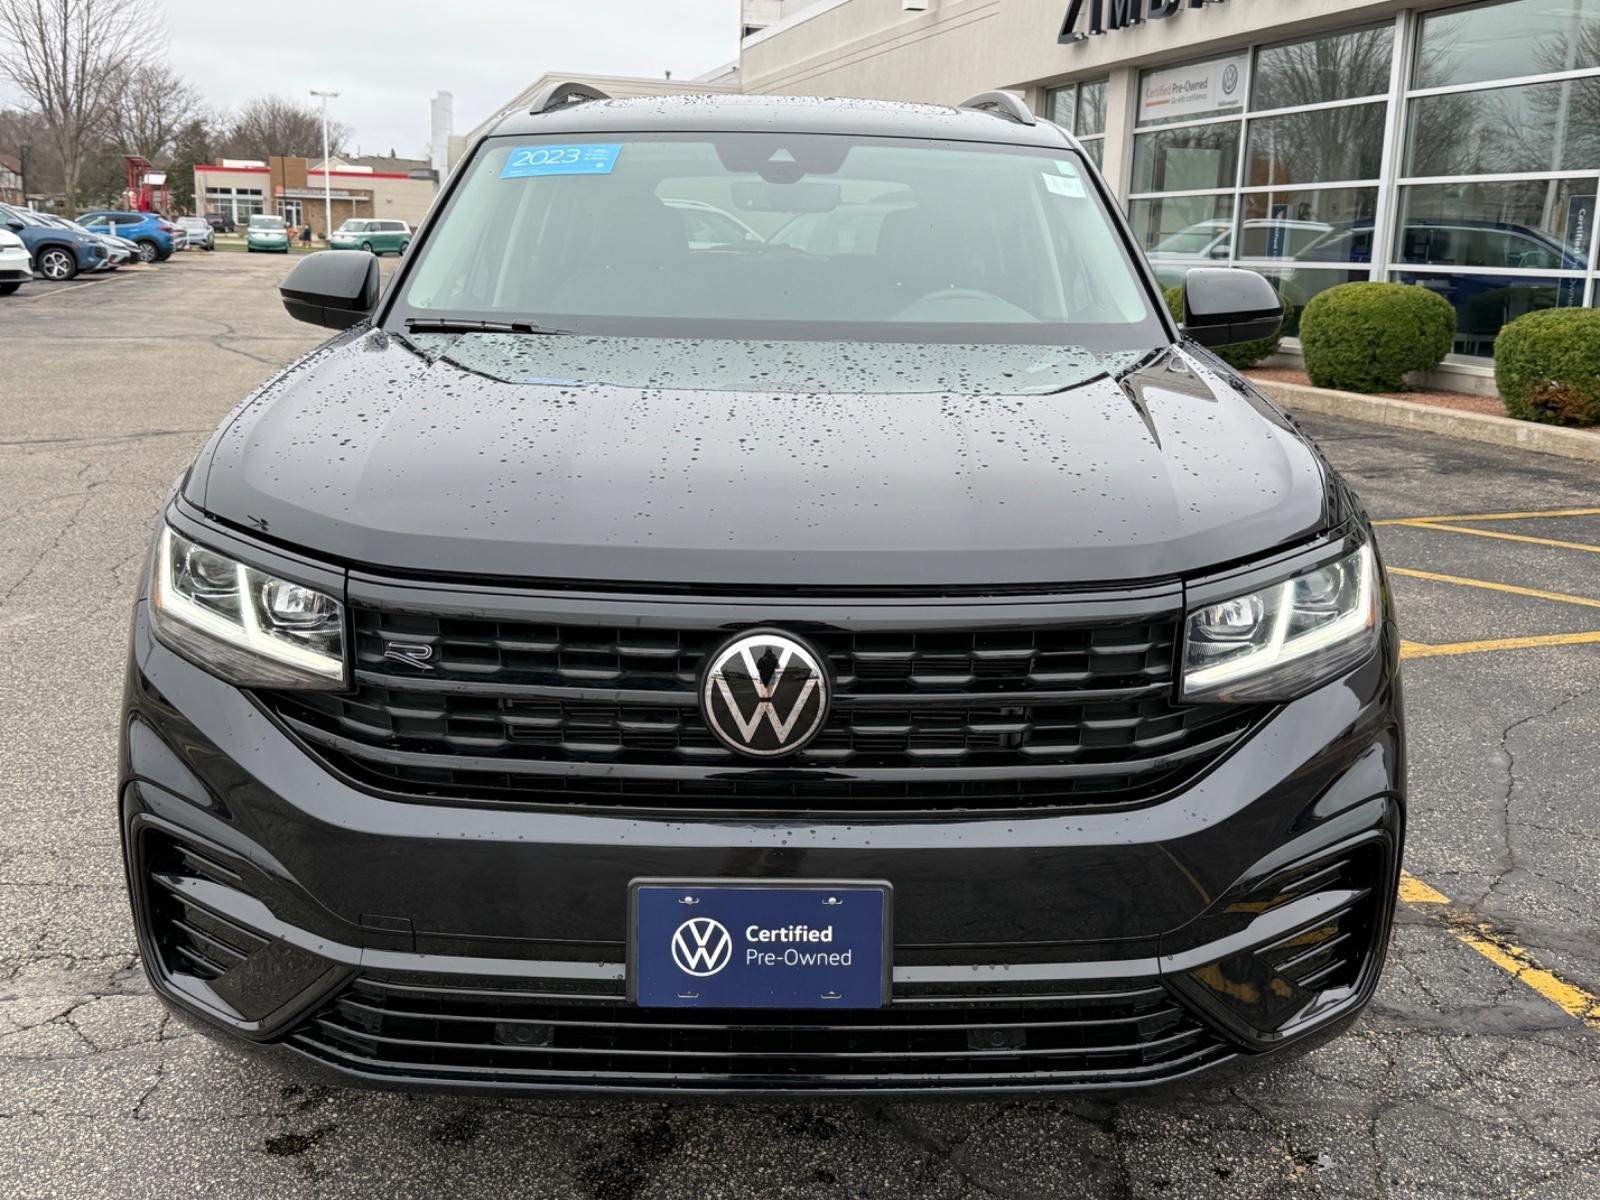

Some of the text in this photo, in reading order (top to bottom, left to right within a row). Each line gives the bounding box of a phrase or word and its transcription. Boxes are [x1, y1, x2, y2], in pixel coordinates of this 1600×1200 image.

[1172, 77, 1208, 94] Pre-Owned
[511, 148, 581, 167] 2023
[1574, 208, 1586, 254] Certified
[384, 642, 434, 669] R
[745, 925, 833, 942] Certified
[746, 949, 852, 966] Pre-Owned
